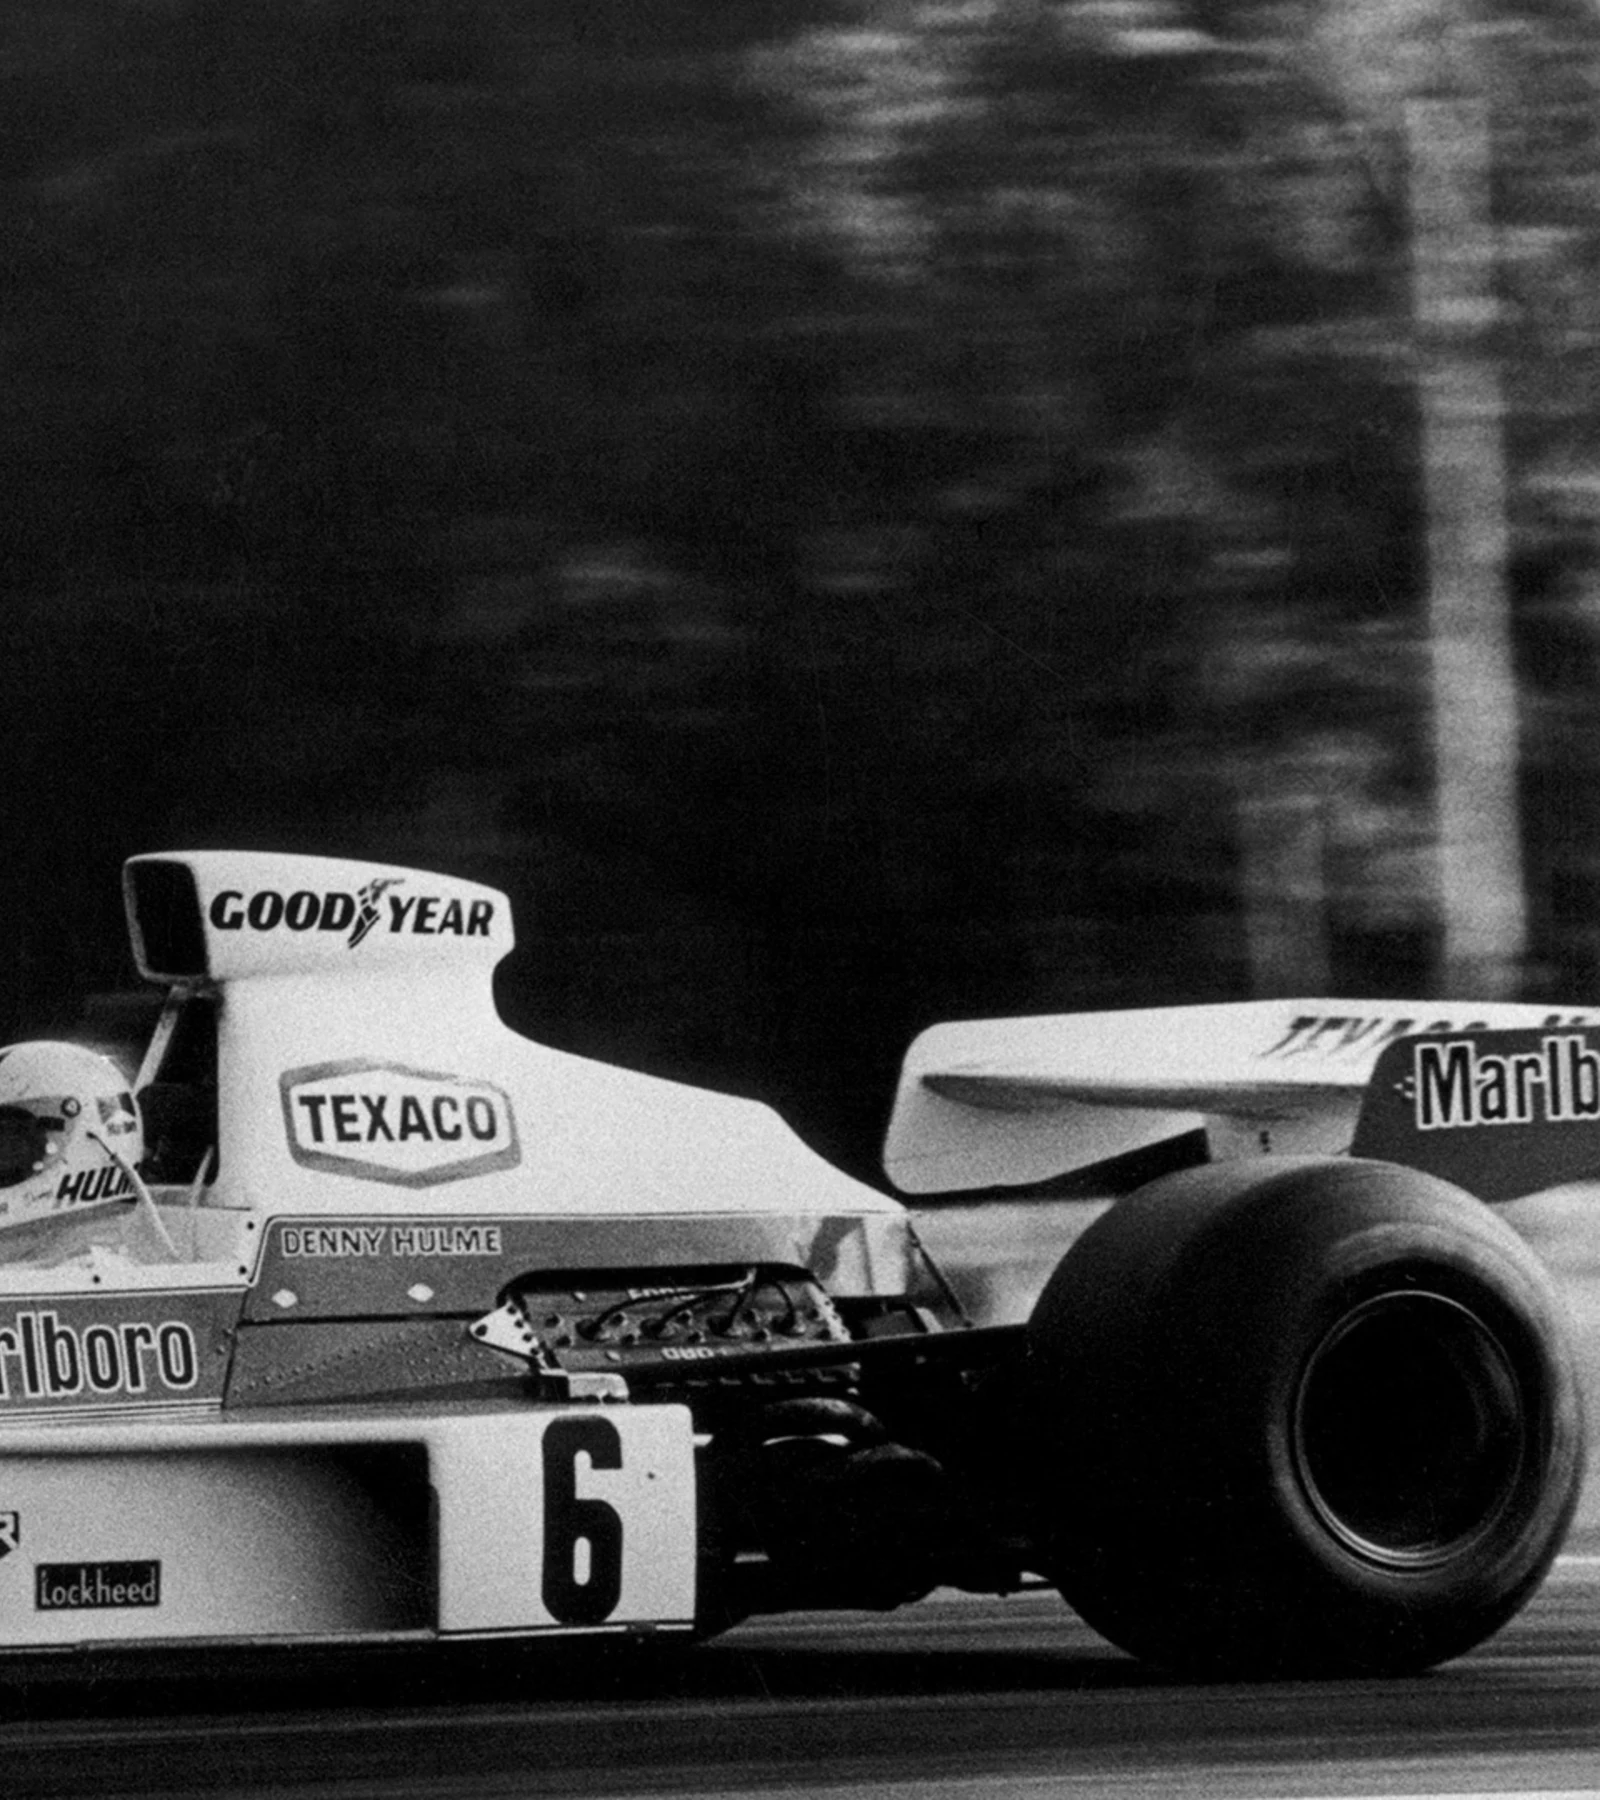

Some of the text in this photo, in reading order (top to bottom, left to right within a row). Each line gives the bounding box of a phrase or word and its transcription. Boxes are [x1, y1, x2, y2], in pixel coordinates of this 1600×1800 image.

[209, 890, 494, 937] GOOD YEAR
[299, 1094, 498, 1143] TEXACO
[281, 1226, 501, 1257] DENNY HULME
[541, 1414, 623, 1624] 6
